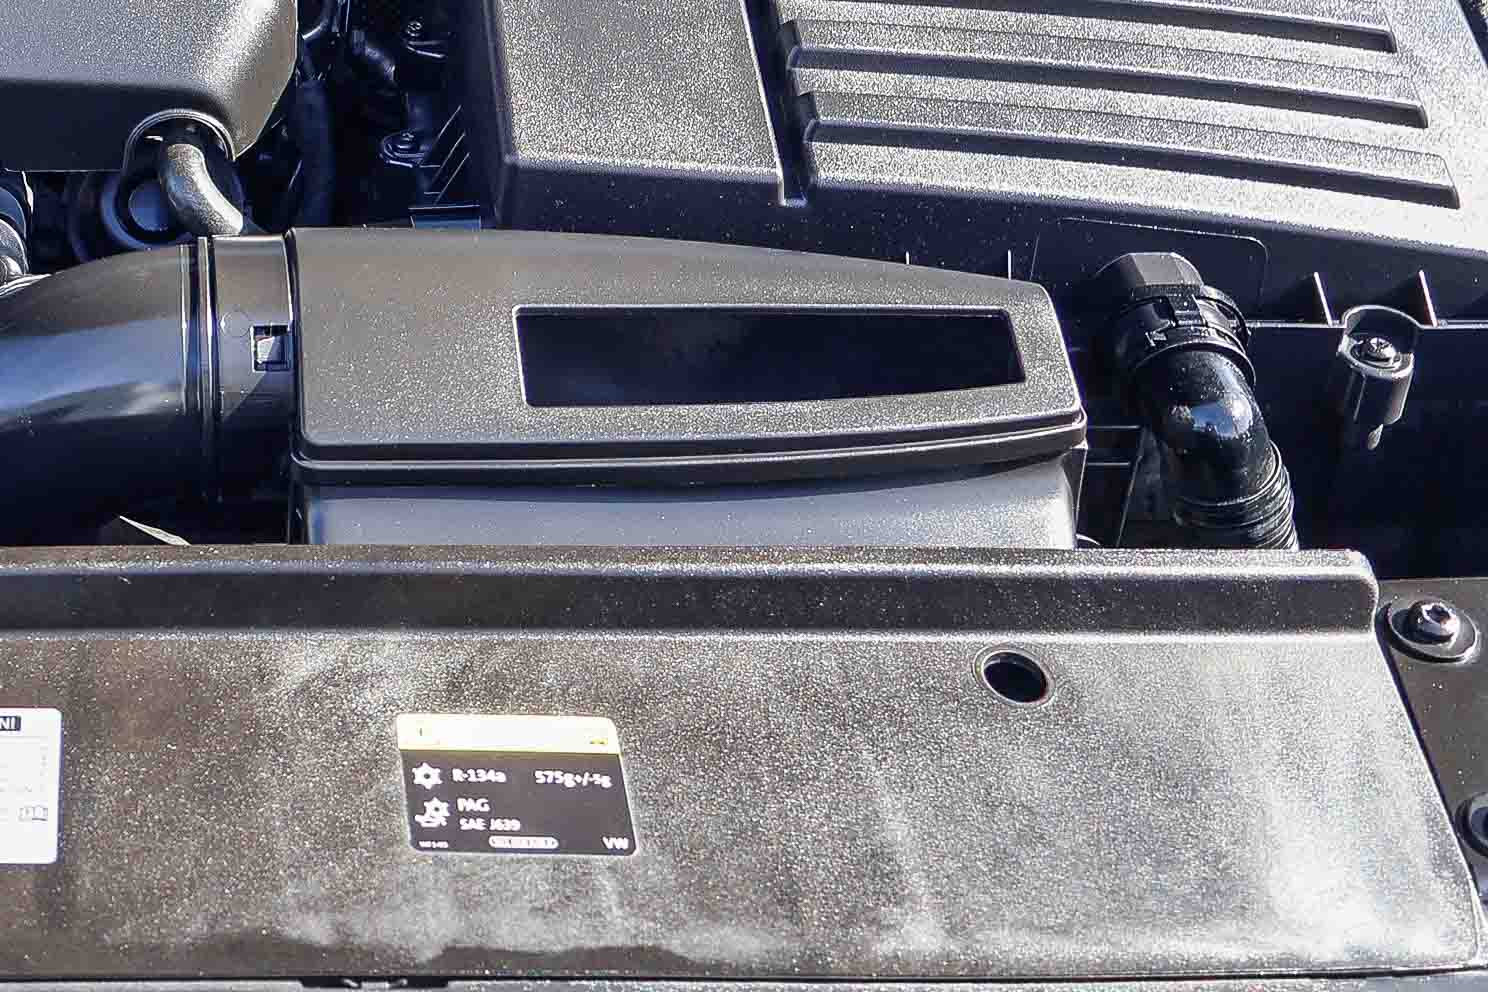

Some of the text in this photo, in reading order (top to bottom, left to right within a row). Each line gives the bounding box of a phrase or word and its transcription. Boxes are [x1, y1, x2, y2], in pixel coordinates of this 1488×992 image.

[452, 768, 507, 783] R-134a
[457, 797, 491, 812] PAG
[459, 817, 487, 830] SAE
[602, 836, 629, 850] VW
